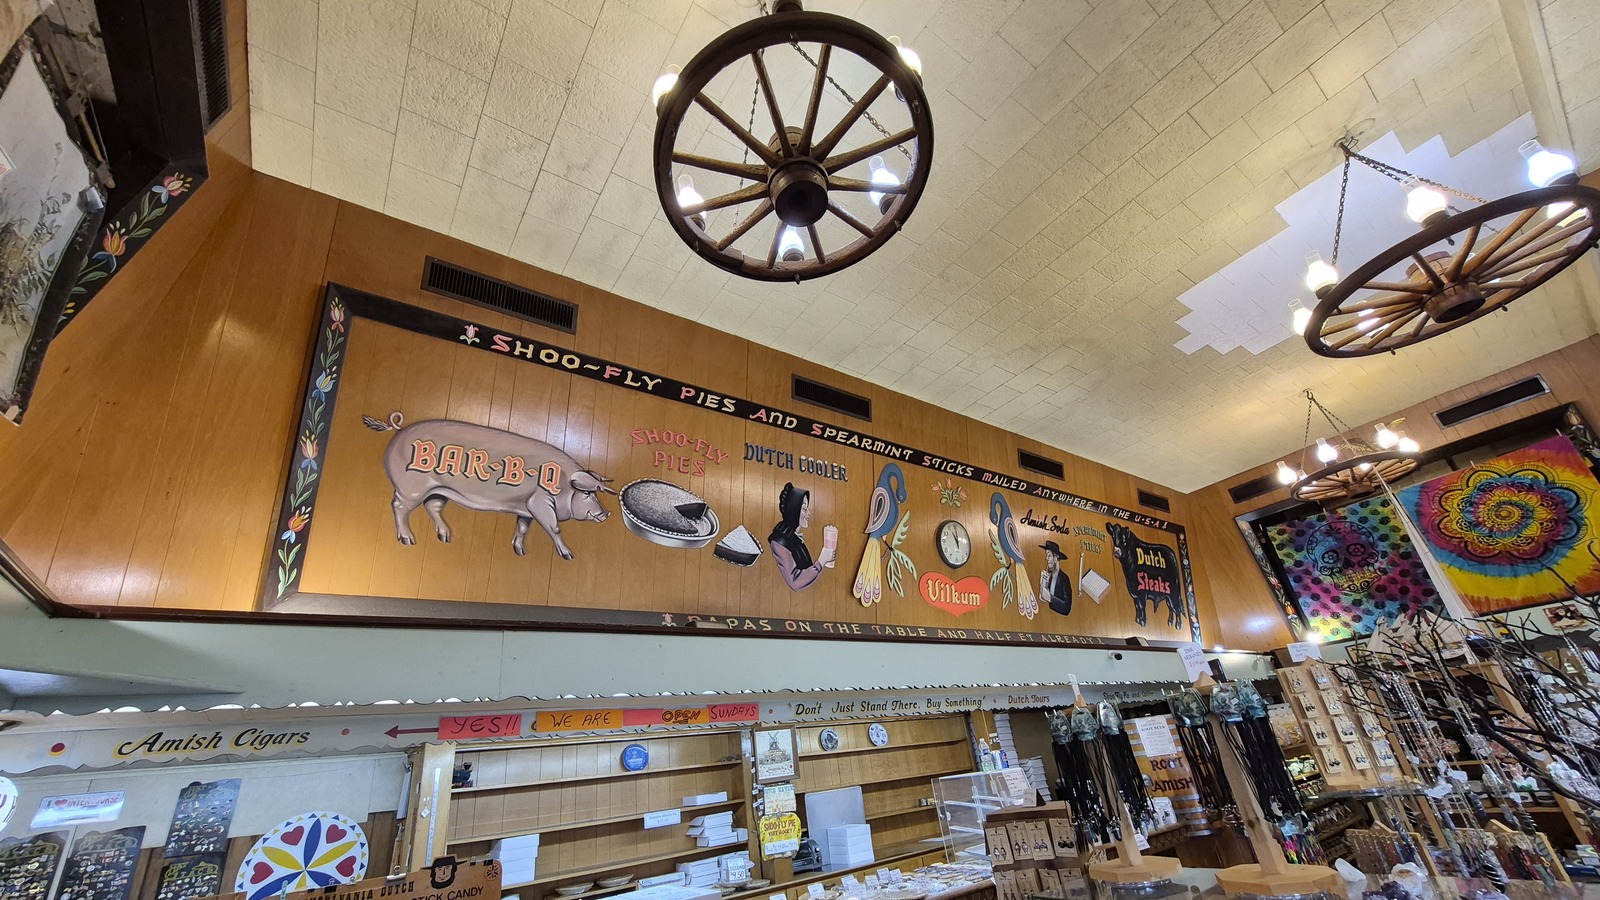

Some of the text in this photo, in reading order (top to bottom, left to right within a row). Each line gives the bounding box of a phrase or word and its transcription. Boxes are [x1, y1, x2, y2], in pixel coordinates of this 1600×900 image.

[629, 427, 729, 466] SHOO-FLY
[680, 386, 737, 413] PIES
[749, 408, 798, 429] AND
[810, 423, 914, 461] SPEARMINT
[921, 454, 975, 478] STICKS
[982, 471, 1028, 492] MAILED
[1033, 486, 1094, 511] ANYWHERE
[1097, 504, 1108, 513] IN
[1112, 508, 1130, 519] THE
[409, 439, 562, 495] BAR-B-Q
[652, 450, 706, 478] PIES
[743, 442, 849, 482] DUTCH COOLER
[1020, 508, 1070, 535] Amish Soda
[1136, 547, 1166, 569] Dutch
[926, 578, 981, 607] Vilkum
[1136, 571, 1172, 594] Steaks
[784, 620, 812, 632] ON
[823, 623, 862, 635] THE
[871, 625, 928, 637] TABLE
[937, 628, 967, 639] AND
[974, 630, 1012, 642] HALF
[1018, 633, 1034, 642] ET
[831, 701, 855, 714] Just
[860, 699, 889, 712] Stand
[926, 698, 942, 710] Buy
[1007, 694, 1050, 705] Dutch Tours
[450, 715, 517, 737] YES!!
[551, 705, 757, 728] WE ARE OPEN SUNDAYS
[116, 727, 311, 757] Amish Cigars
[380, 880, 415, 898] DUTCH
[447, 885, 484, 900] CANDY
